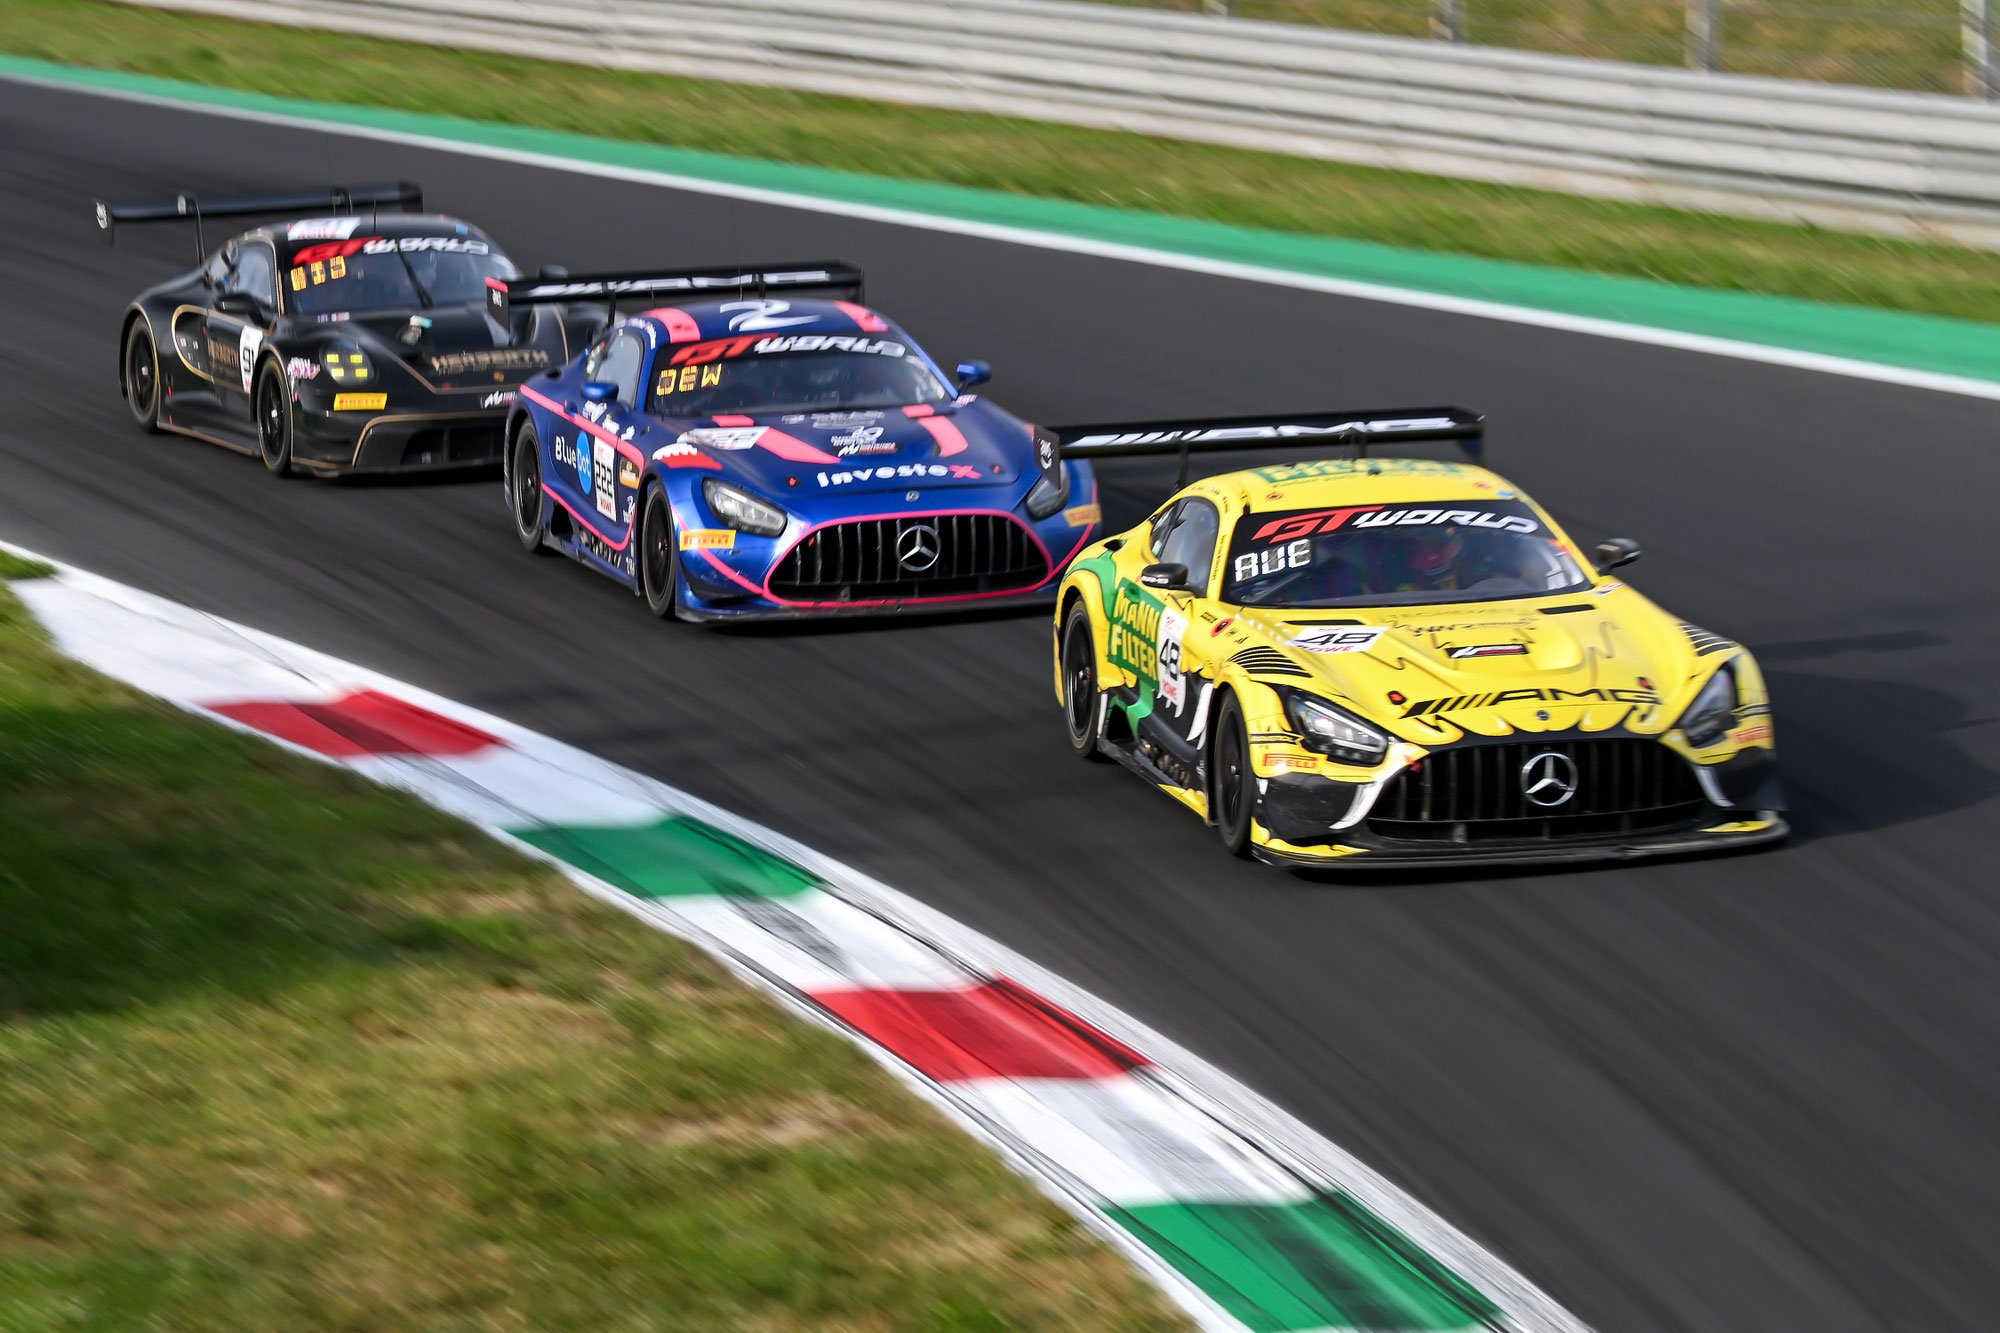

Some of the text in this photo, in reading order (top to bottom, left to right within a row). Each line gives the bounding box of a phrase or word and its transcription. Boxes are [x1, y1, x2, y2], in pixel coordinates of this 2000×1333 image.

[670, 333, 779, 366] GT
[754, 336, 906, 358] WORLD
[595, 461, 613, 498] 222
[1251, 505, 1539, 543] GT WORLD
[1113, 586, 1161, 644] MANN
[1111, 623, 1159, 682] FILTER
[1294, 632, 1378, 646] 48
[1160, 638, 1180, 682] 48
[1488, 687, 1662, 706] AMG
[1263, 753, 1318, 770] PIRELLI
